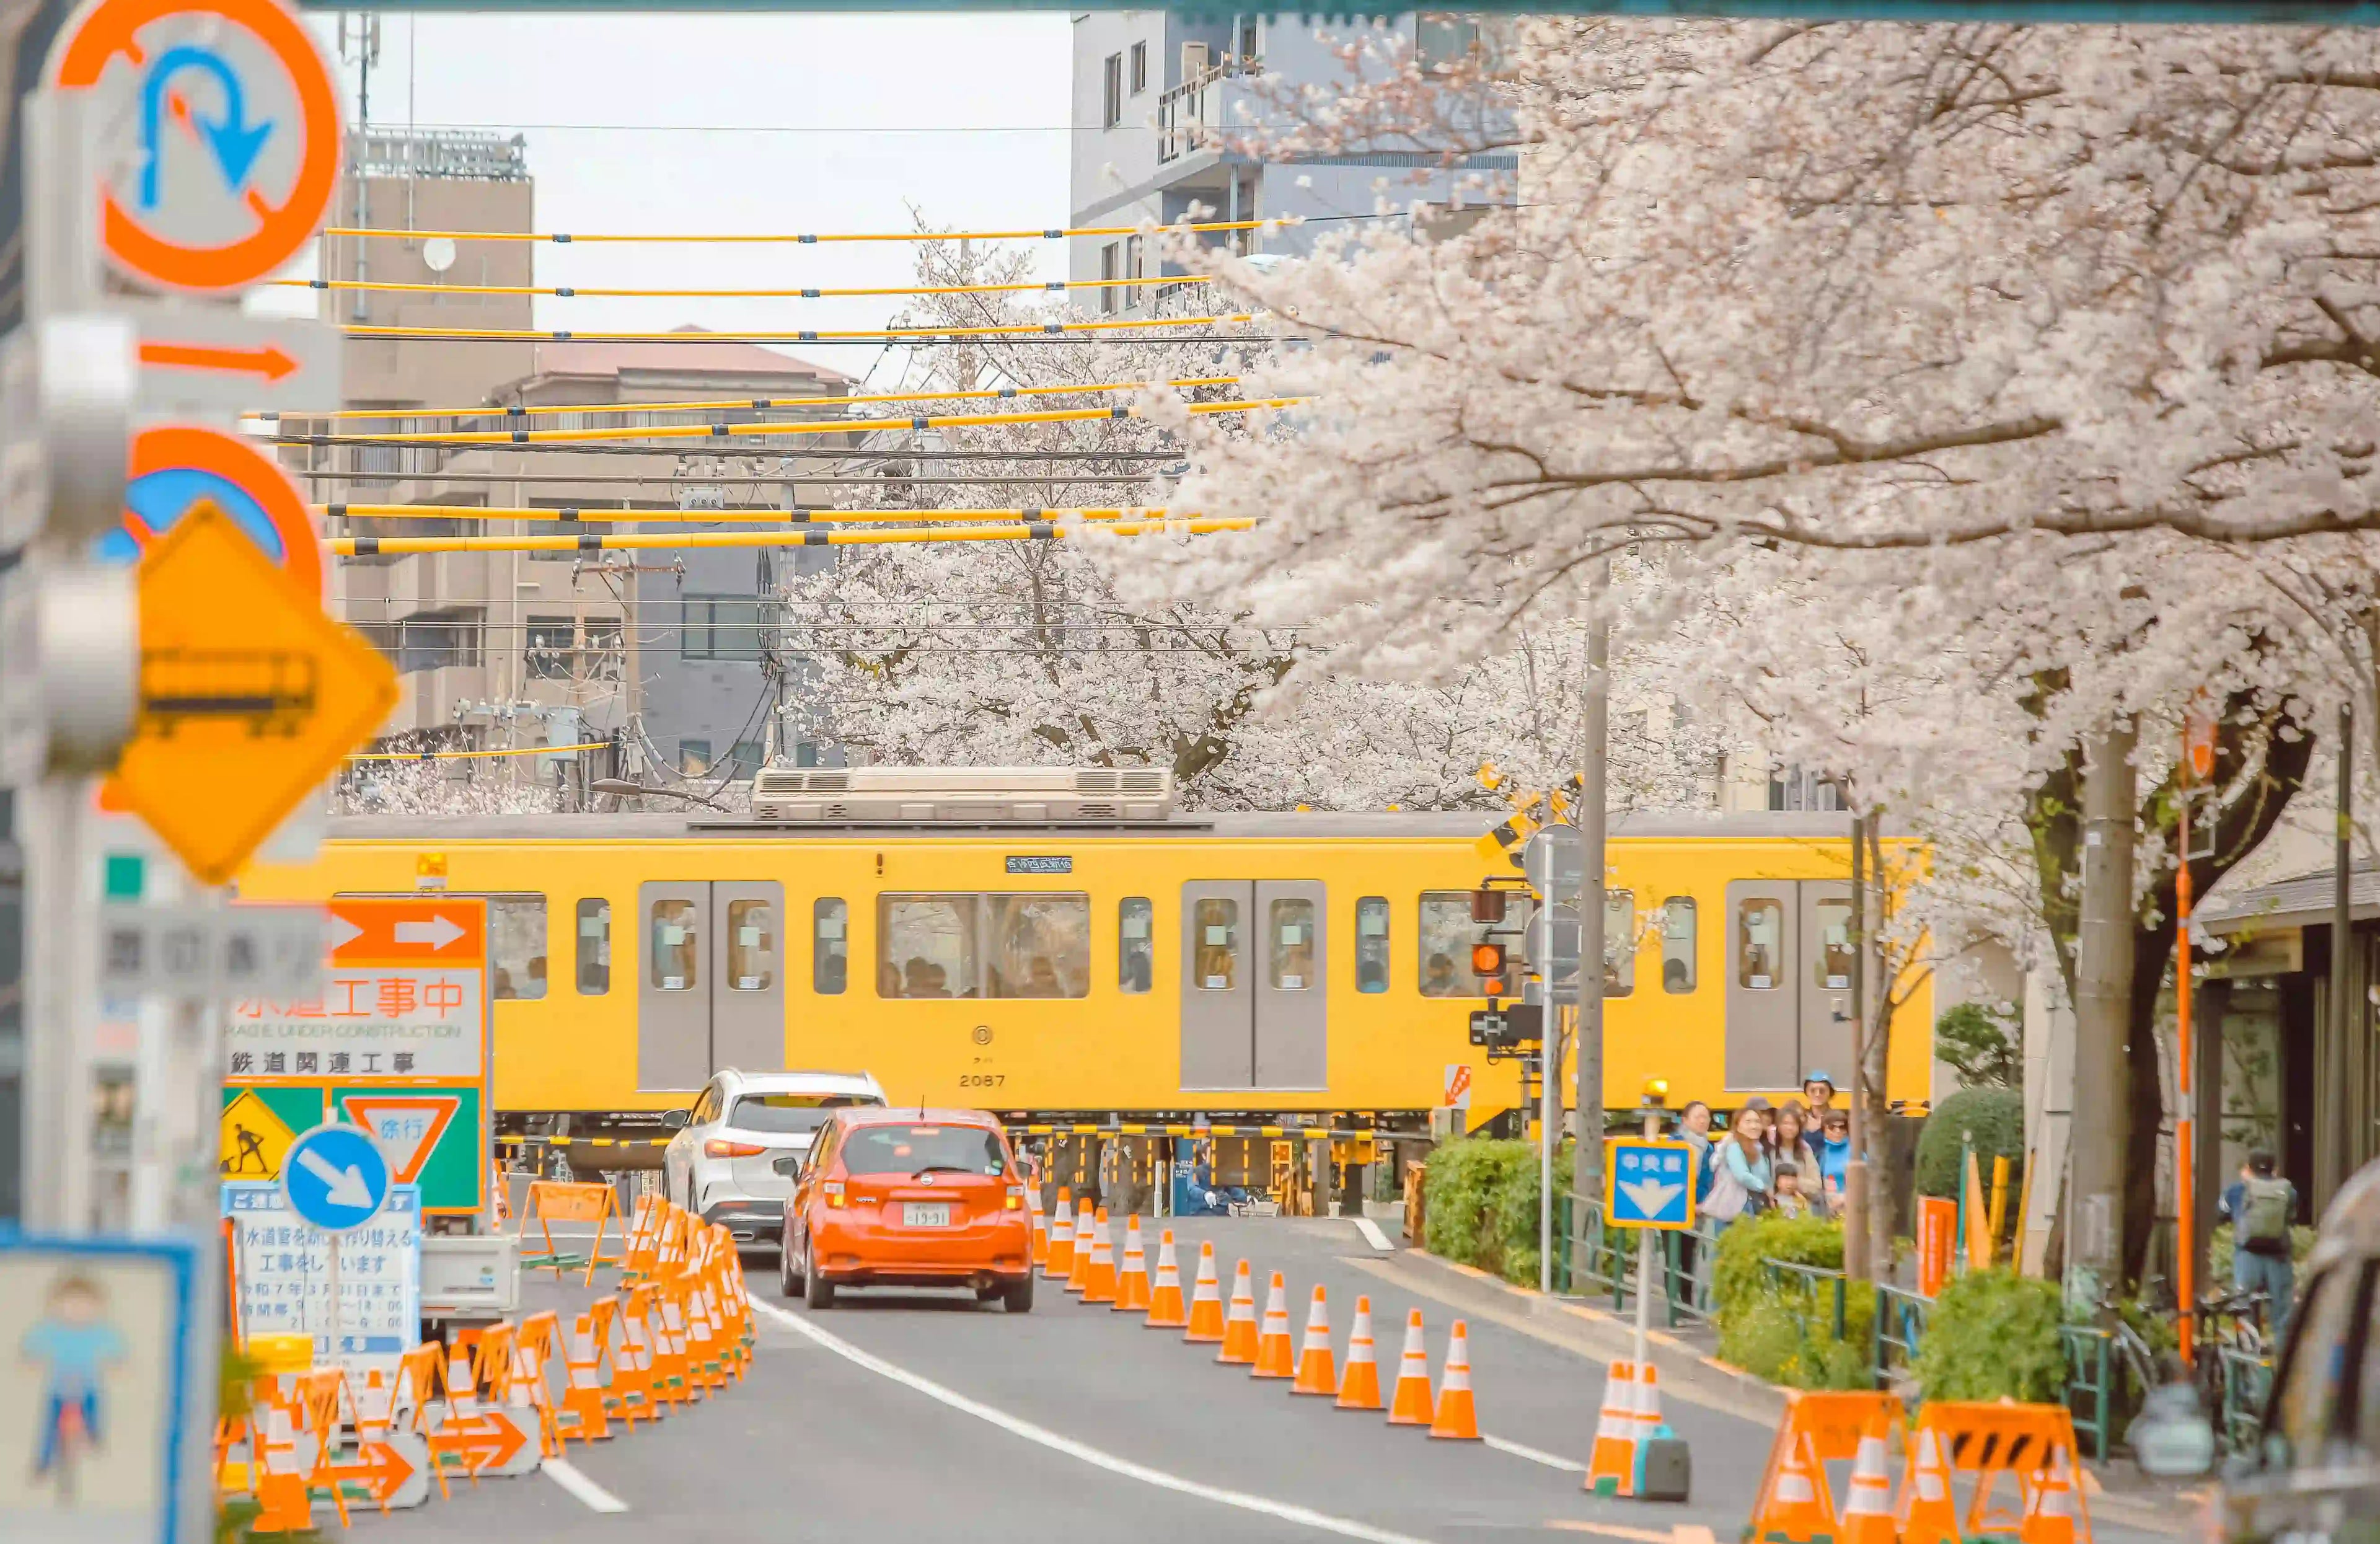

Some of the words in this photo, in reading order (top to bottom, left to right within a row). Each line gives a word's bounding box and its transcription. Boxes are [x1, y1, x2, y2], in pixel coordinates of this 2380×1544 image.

[278, 1024, 333, 1038] UNDER
[335, 1024, 461, 1038] CONSTRUCTION
[960, 1075, 1005, 1087] 2087
[381, 1118, 423, 1139] 徐行
[259, 1253, 386, 1274] 工事をしいます
